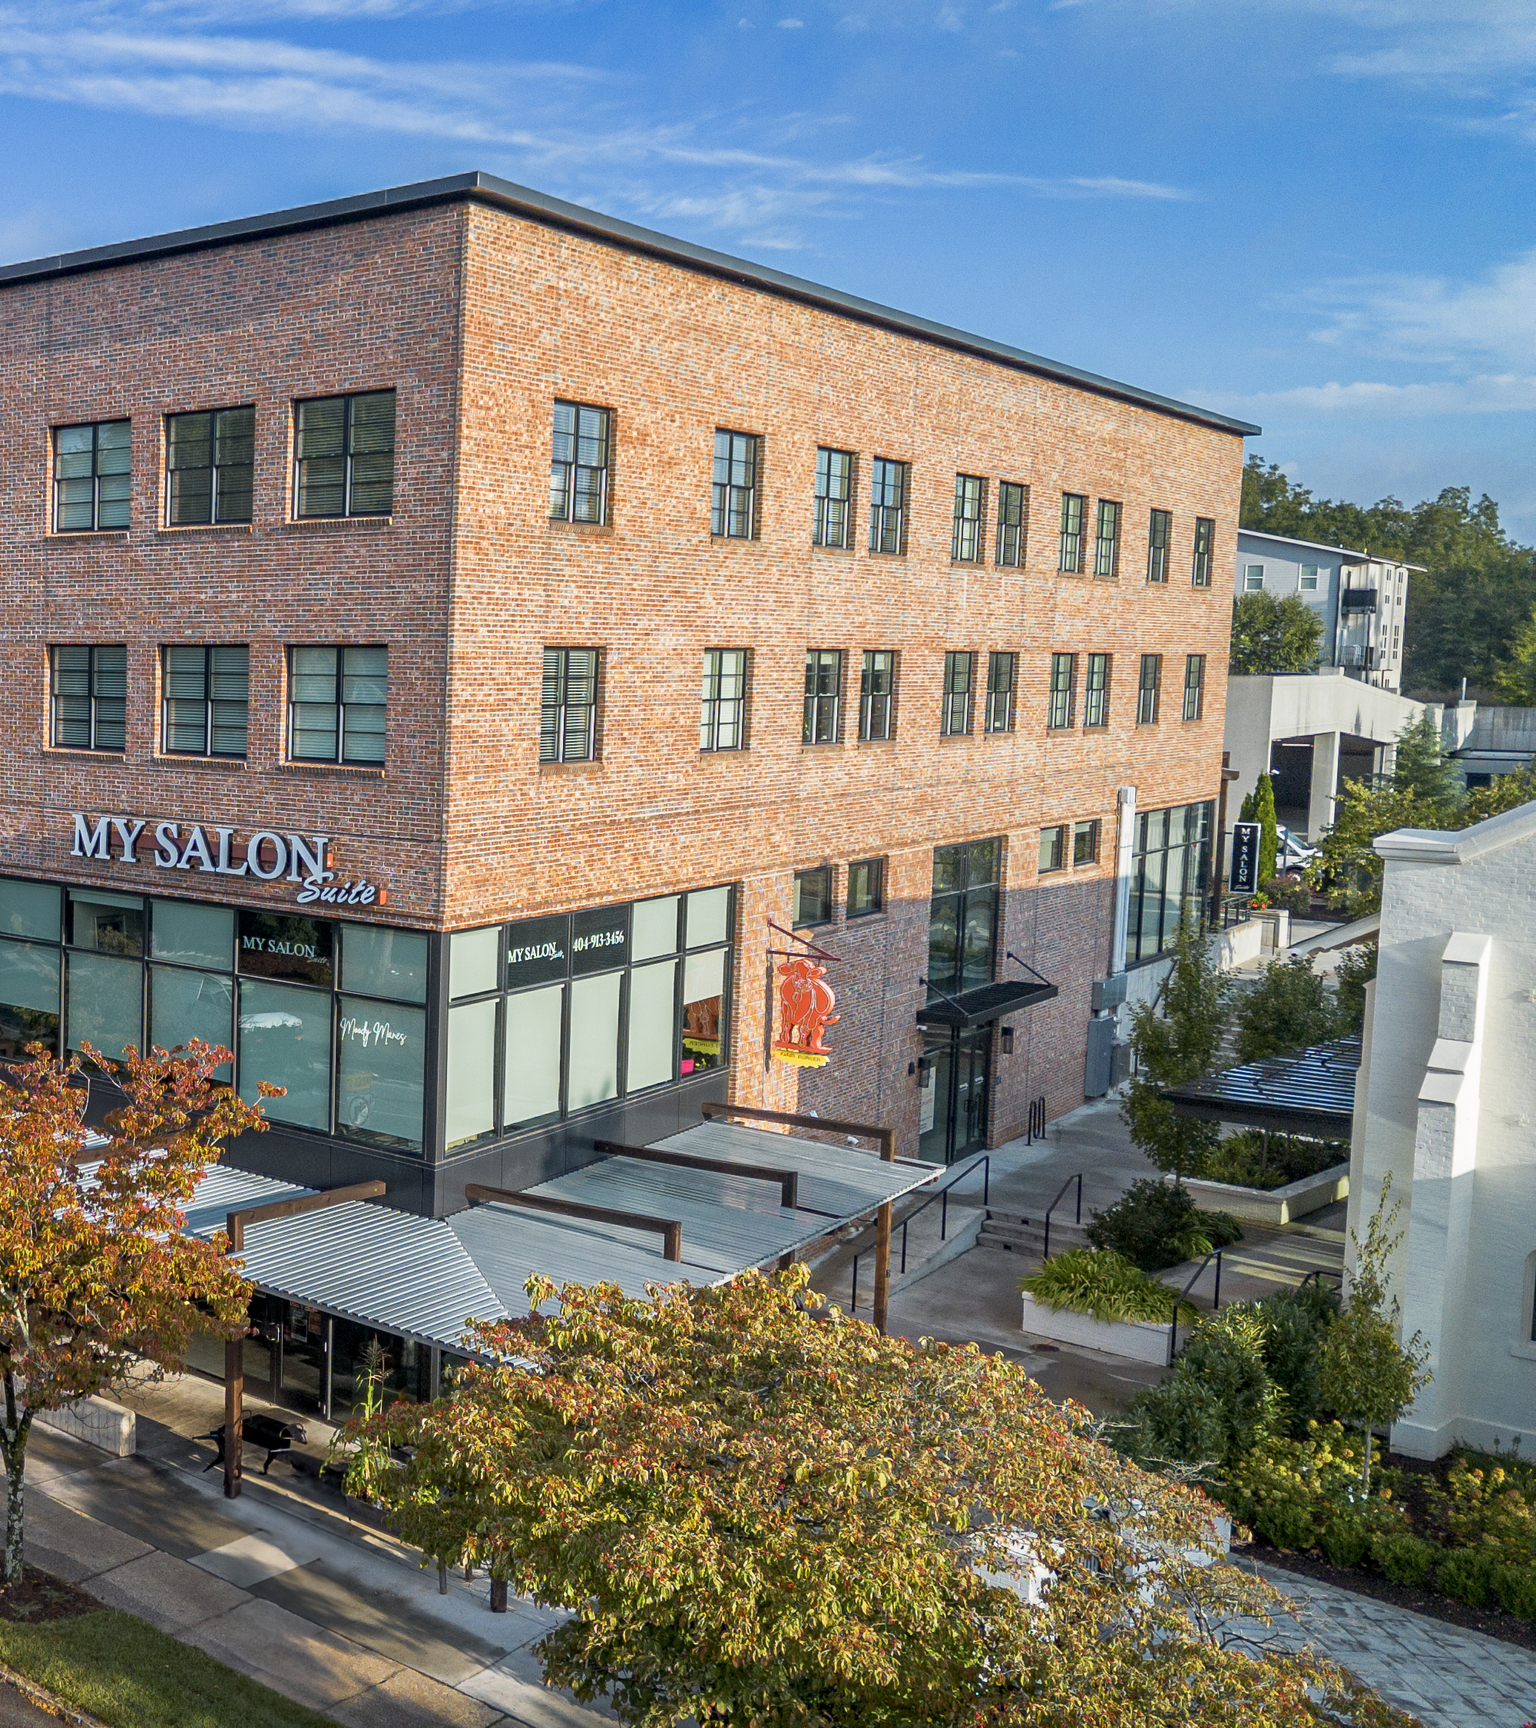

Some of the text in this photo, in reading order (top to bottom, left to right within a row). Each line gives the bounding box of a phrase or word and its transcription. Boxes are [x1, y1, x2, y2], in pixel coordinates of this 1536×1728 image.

[70, 813, 330, 883] MY SALON
[1239, 827, 1251, 882] MY SALON
[297, 871, 375, 905] Suite
[243, 935, 315, 958] MY SALON
[508, 941, 556, 963] MY SALON
[572, 929, 625, 953] 404-913-3456
